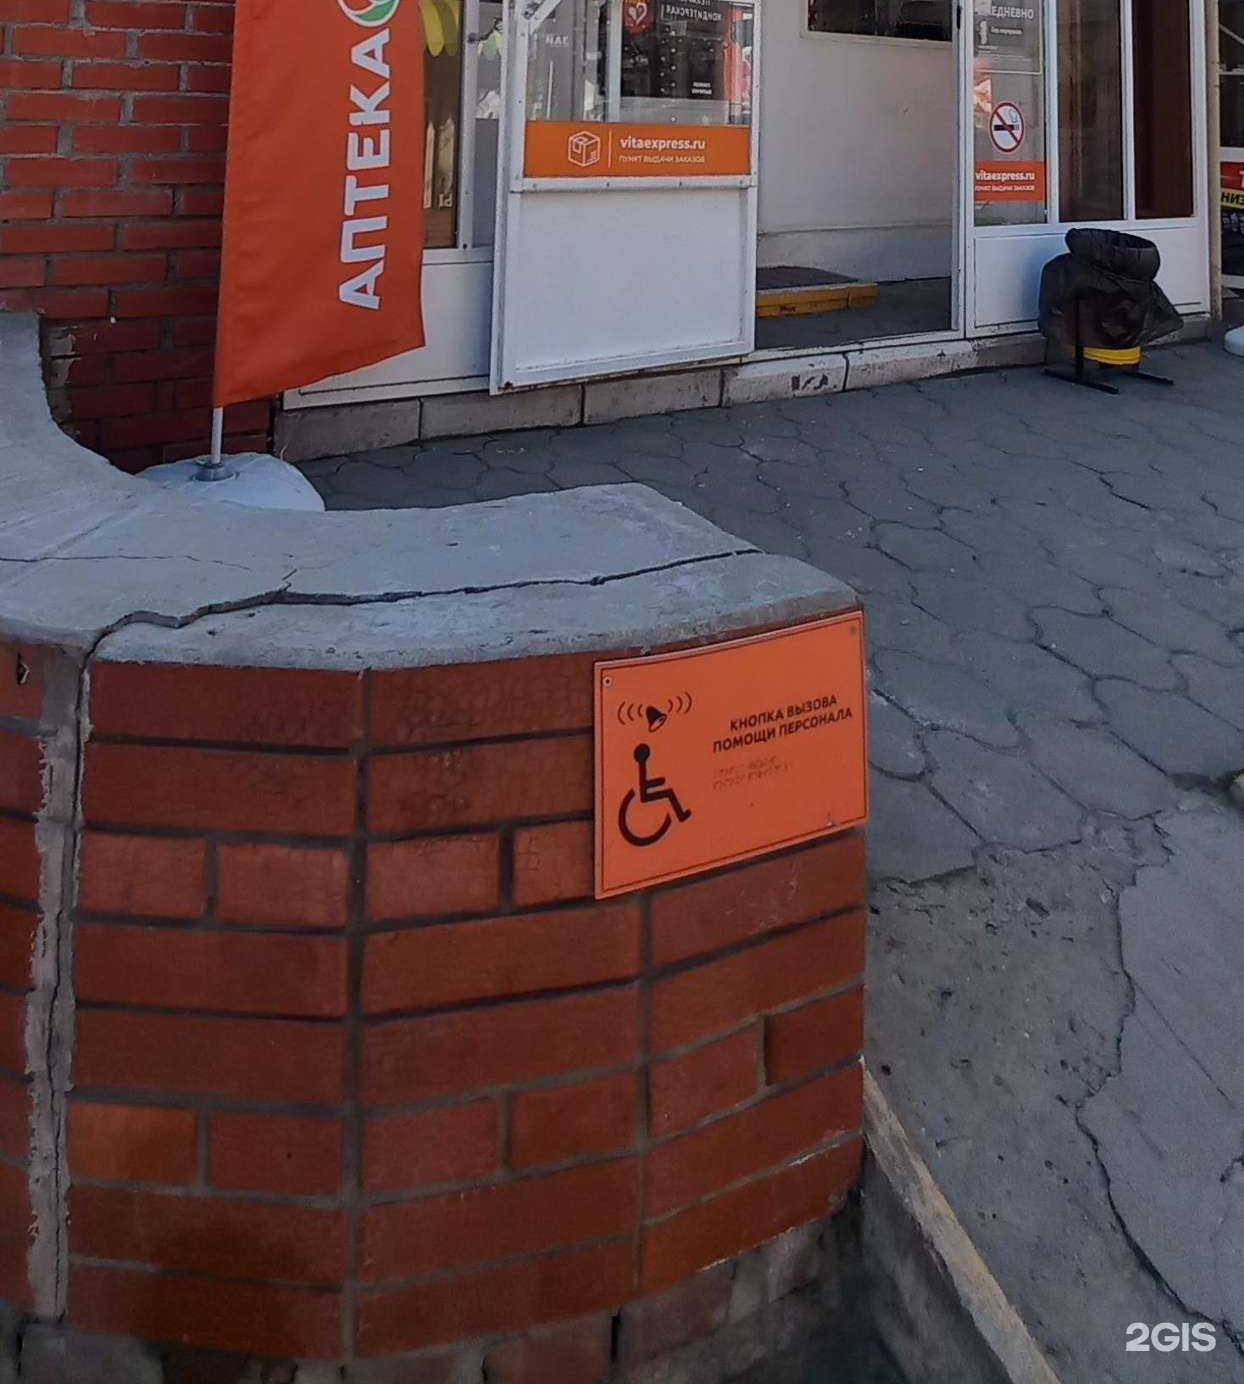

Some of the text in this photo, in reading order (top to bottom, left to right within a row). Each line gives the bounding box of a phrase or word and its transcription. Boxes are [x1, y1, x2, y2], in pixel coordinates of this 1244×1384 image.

[619, 135, 706, 151] vitaexpress.ru
[339, 28, 390, 311] АПТЕКА
[618, 154, 642, 163] ПУНКТ
[975, 169, 1035, 182] vitaexpress.ru
[730, 694, 838, 732] КНОПКА ВЫЗОВА
[712, 707, 853, 754] ПОМОЩИ ПЕРСОНАЛА
